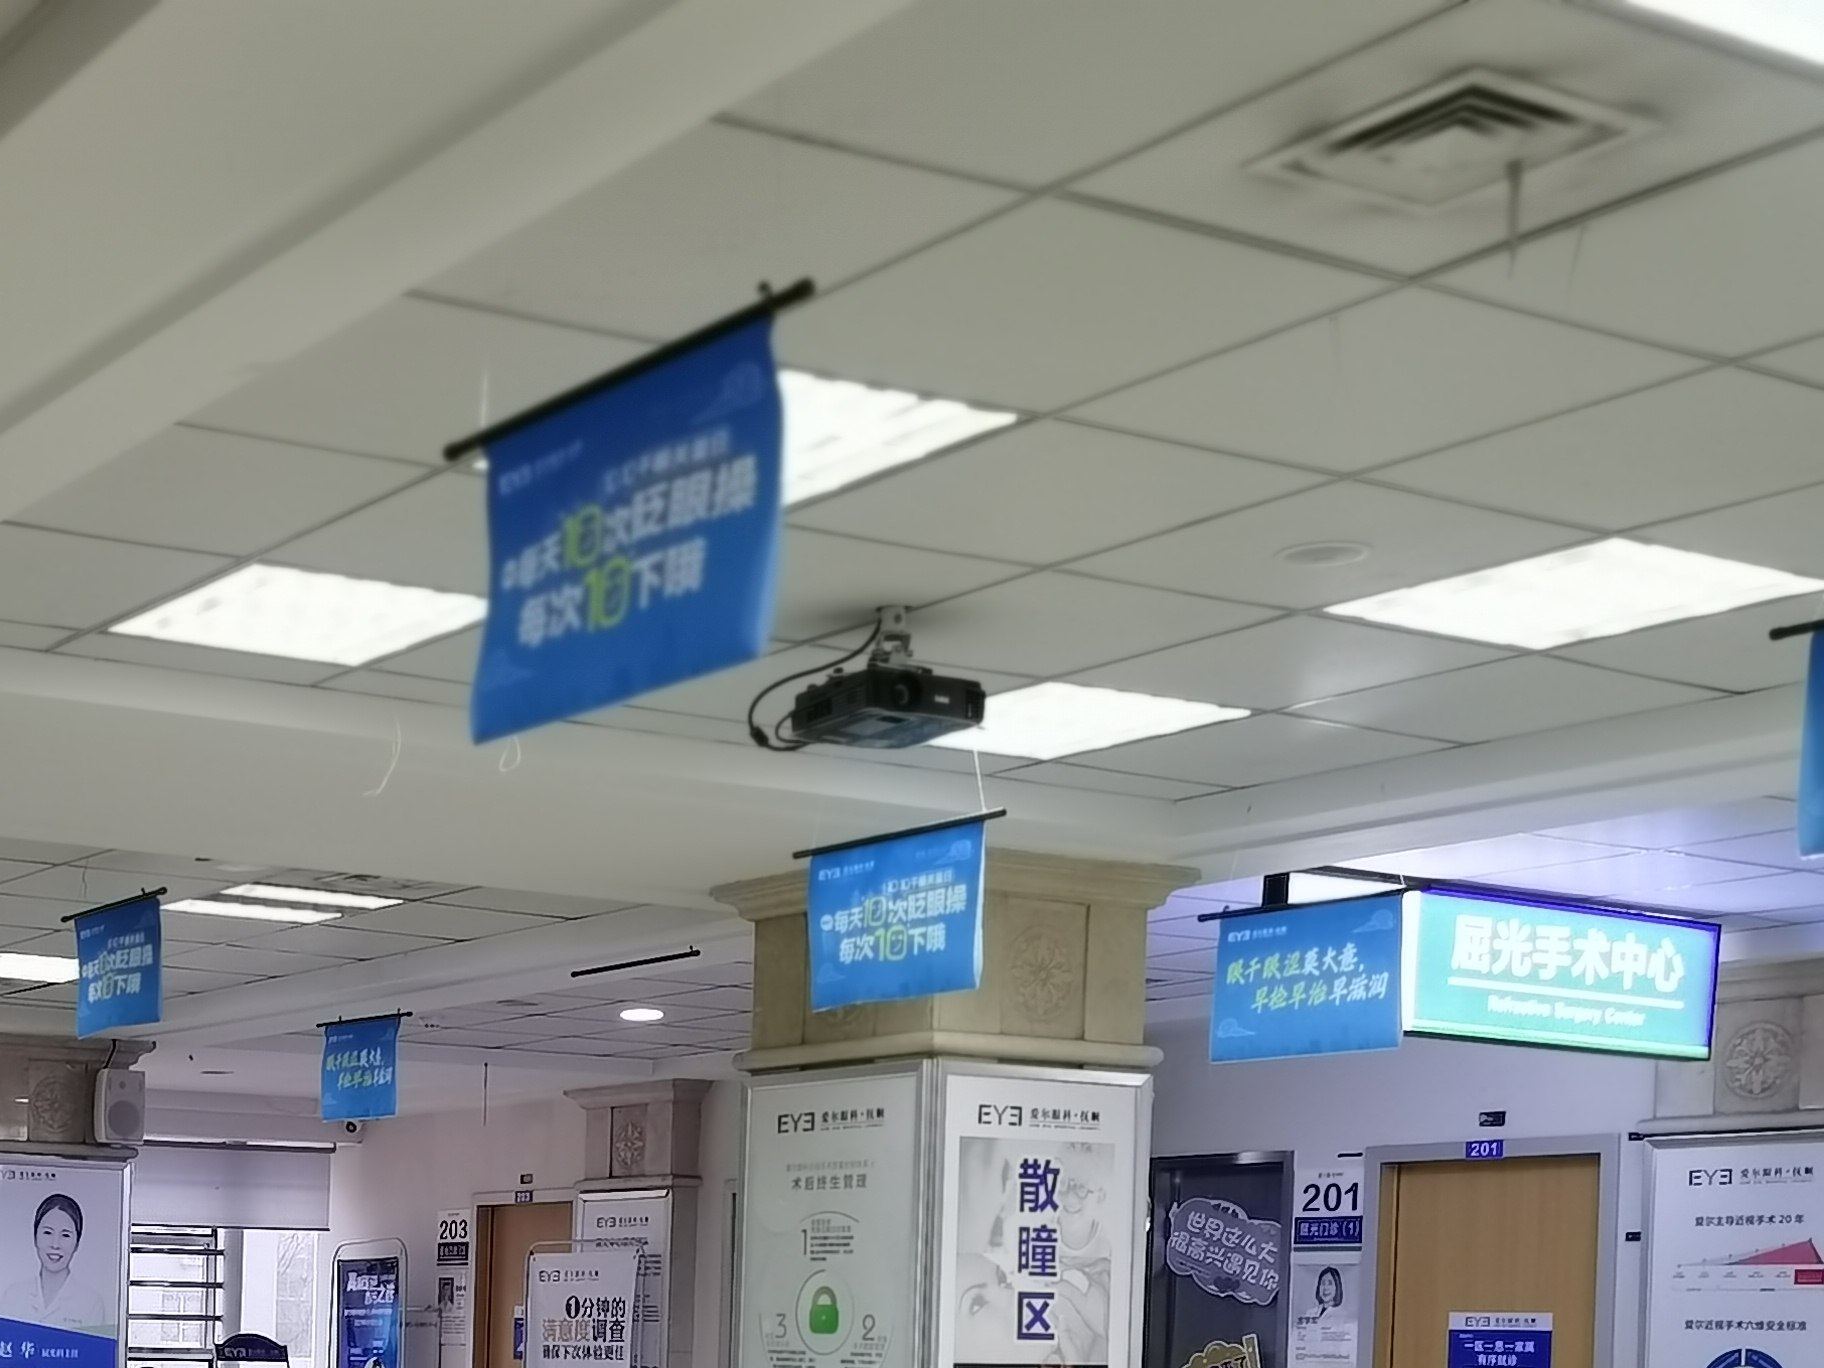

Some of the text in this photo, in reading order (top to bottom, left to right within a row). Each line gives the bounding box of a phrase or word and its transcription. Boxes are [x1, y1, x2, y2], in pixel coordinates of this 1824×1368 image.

[1451, 914, 1685, 993] 屈光手术中心
[1471, 1142, 1497, 1157] 201
[1302, 1182, 1359, 1212] 201
[439, 1219, 468, 1240] 203
[1017, 1158, 1061, 1341] 散瞳区
[775, 1313, 787, 1339] 3
[862, 1314, 876, 1341] 2
